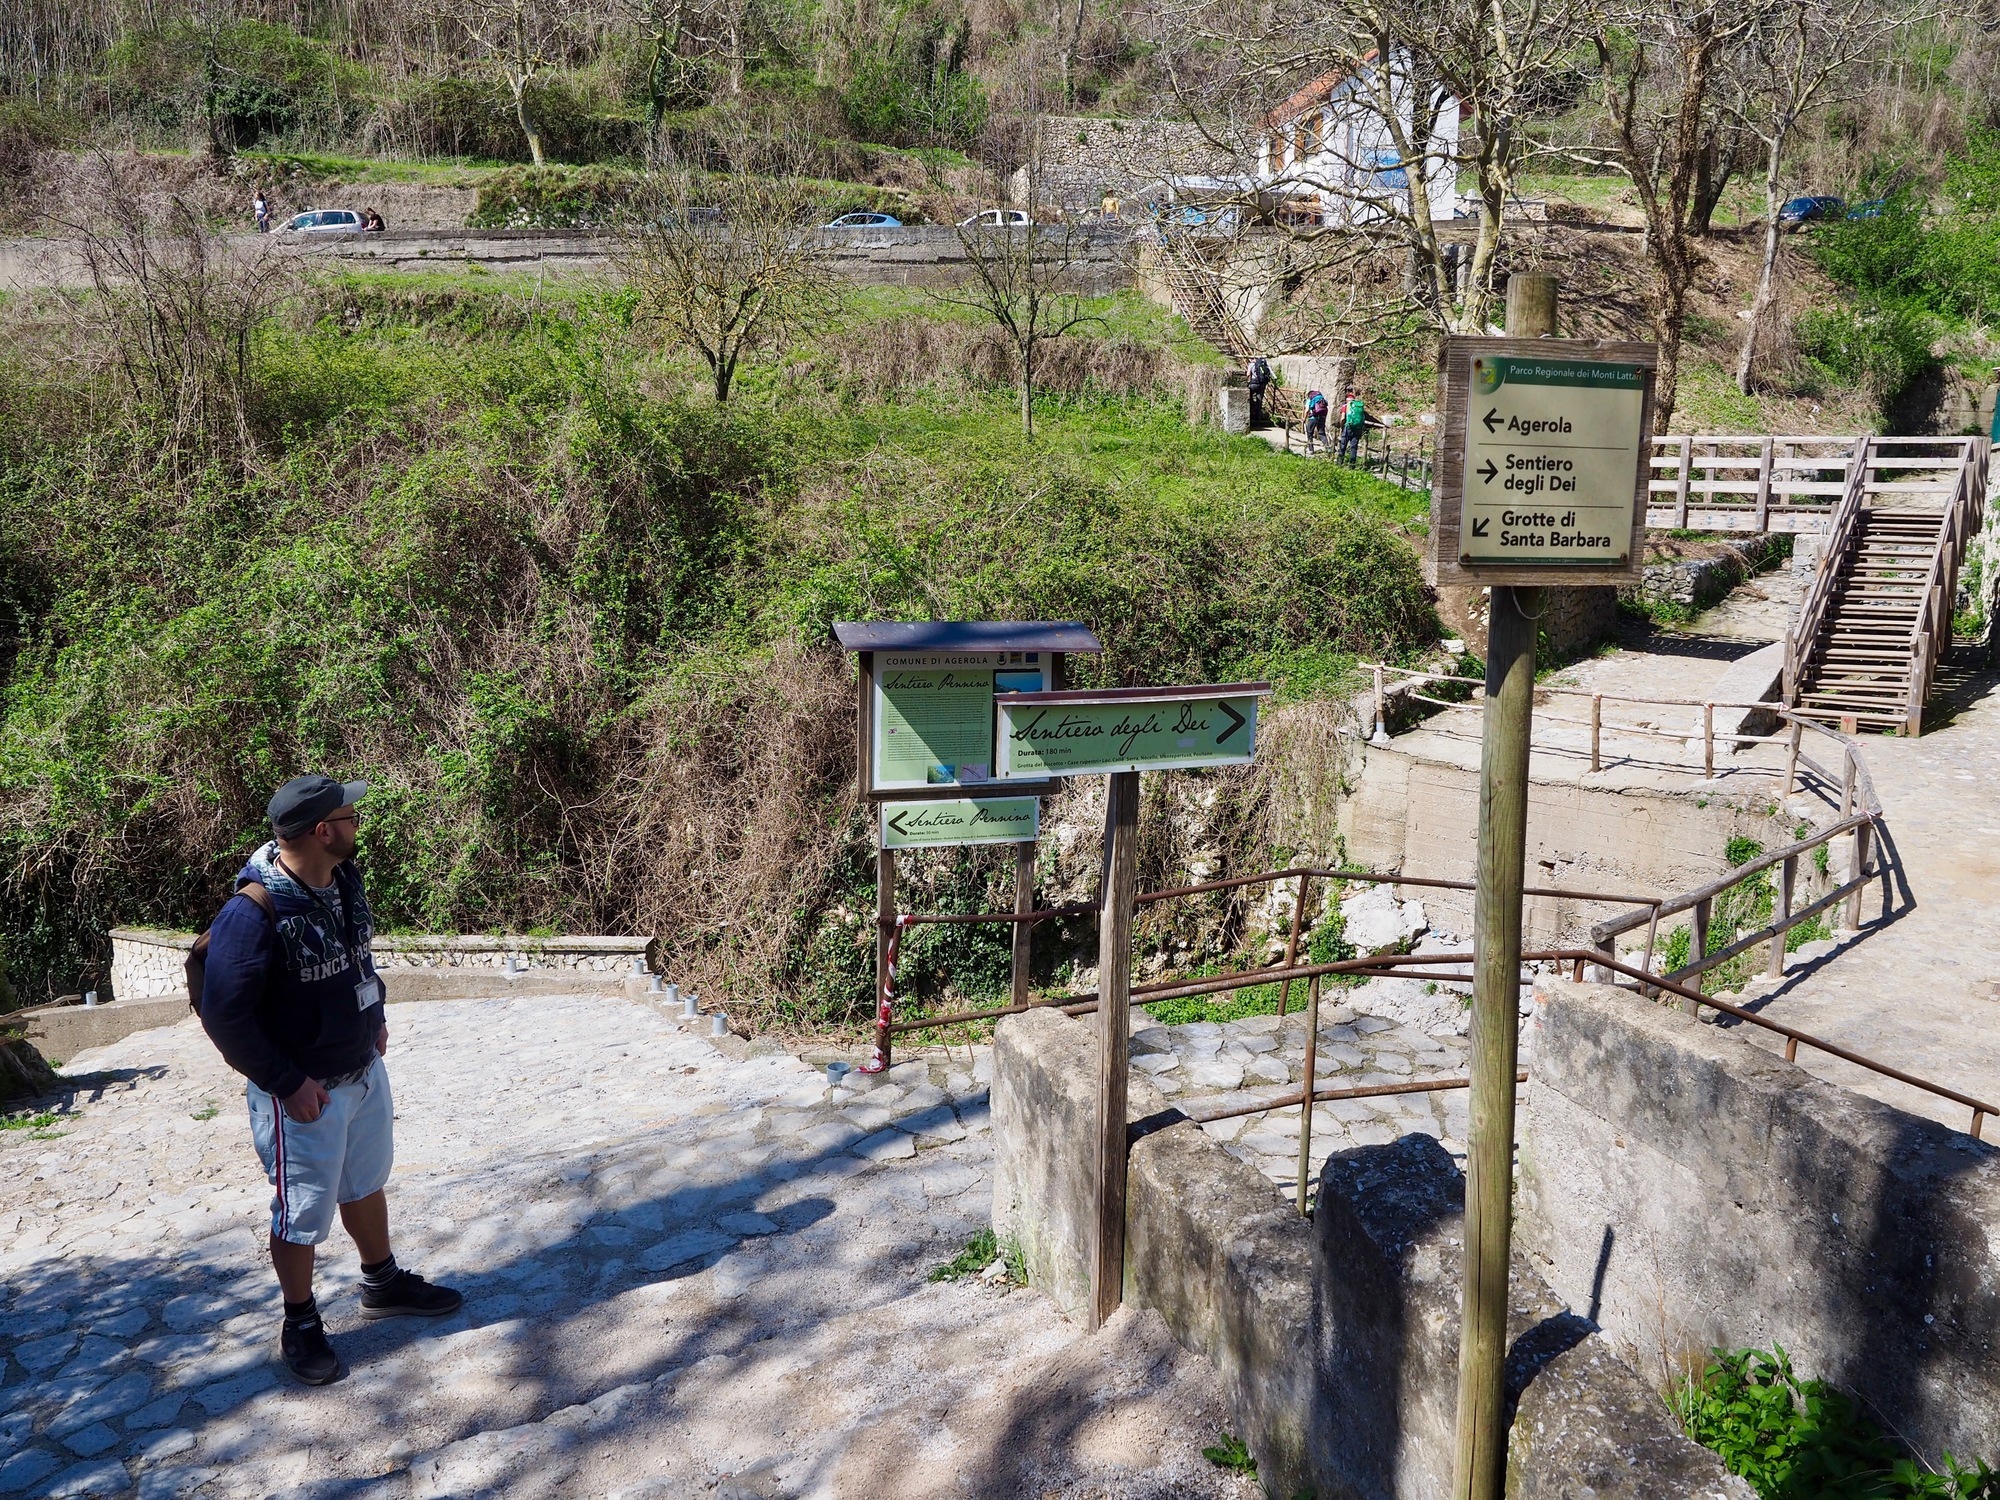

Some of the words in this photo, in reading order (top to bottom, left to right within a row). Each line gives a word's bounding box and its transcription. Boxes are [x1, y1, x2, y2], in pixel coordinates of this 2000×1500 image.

[1510, 365, 1533, 376] Parco
[1535, 366, 1575, 379] Regionale
[1577, 368, 1590, 379] dei
[1591, 369, 1615, 380] Monti
[1507, 415, 1572, 436] Agerola
[1505, 453, 1573, 472] Sentiero
[1504, 474, 1544, 495] degli
[1550, 476, 1576, 492] Dei
[1502, 510, 1555, 527] Grotte
[1560, 511, 1576, 527] di
[1500, 530, 1545, 547] Santa
[1550, 532, 1611, 548] Barbara
[886, 657, 927, 666] COMUNE
[931, 657, 941, 665] DI
[944, 656, 988, 665] AGEROLA
[884, 673, 934, 690] Sentiero
[938, 673, 990, 691] Pennino
[1009, 708, 1104, 742] Sentiero
[1110, 709, 1165, 756] degli
[1171, 703, 1213, 735] Dei
[1046, 747, 1058, 755] 180
[905, 809, 965, 828] Sentiero
[970, 808, 1031, 826] Pennino
[300, 954, 350, 983] SINCE
